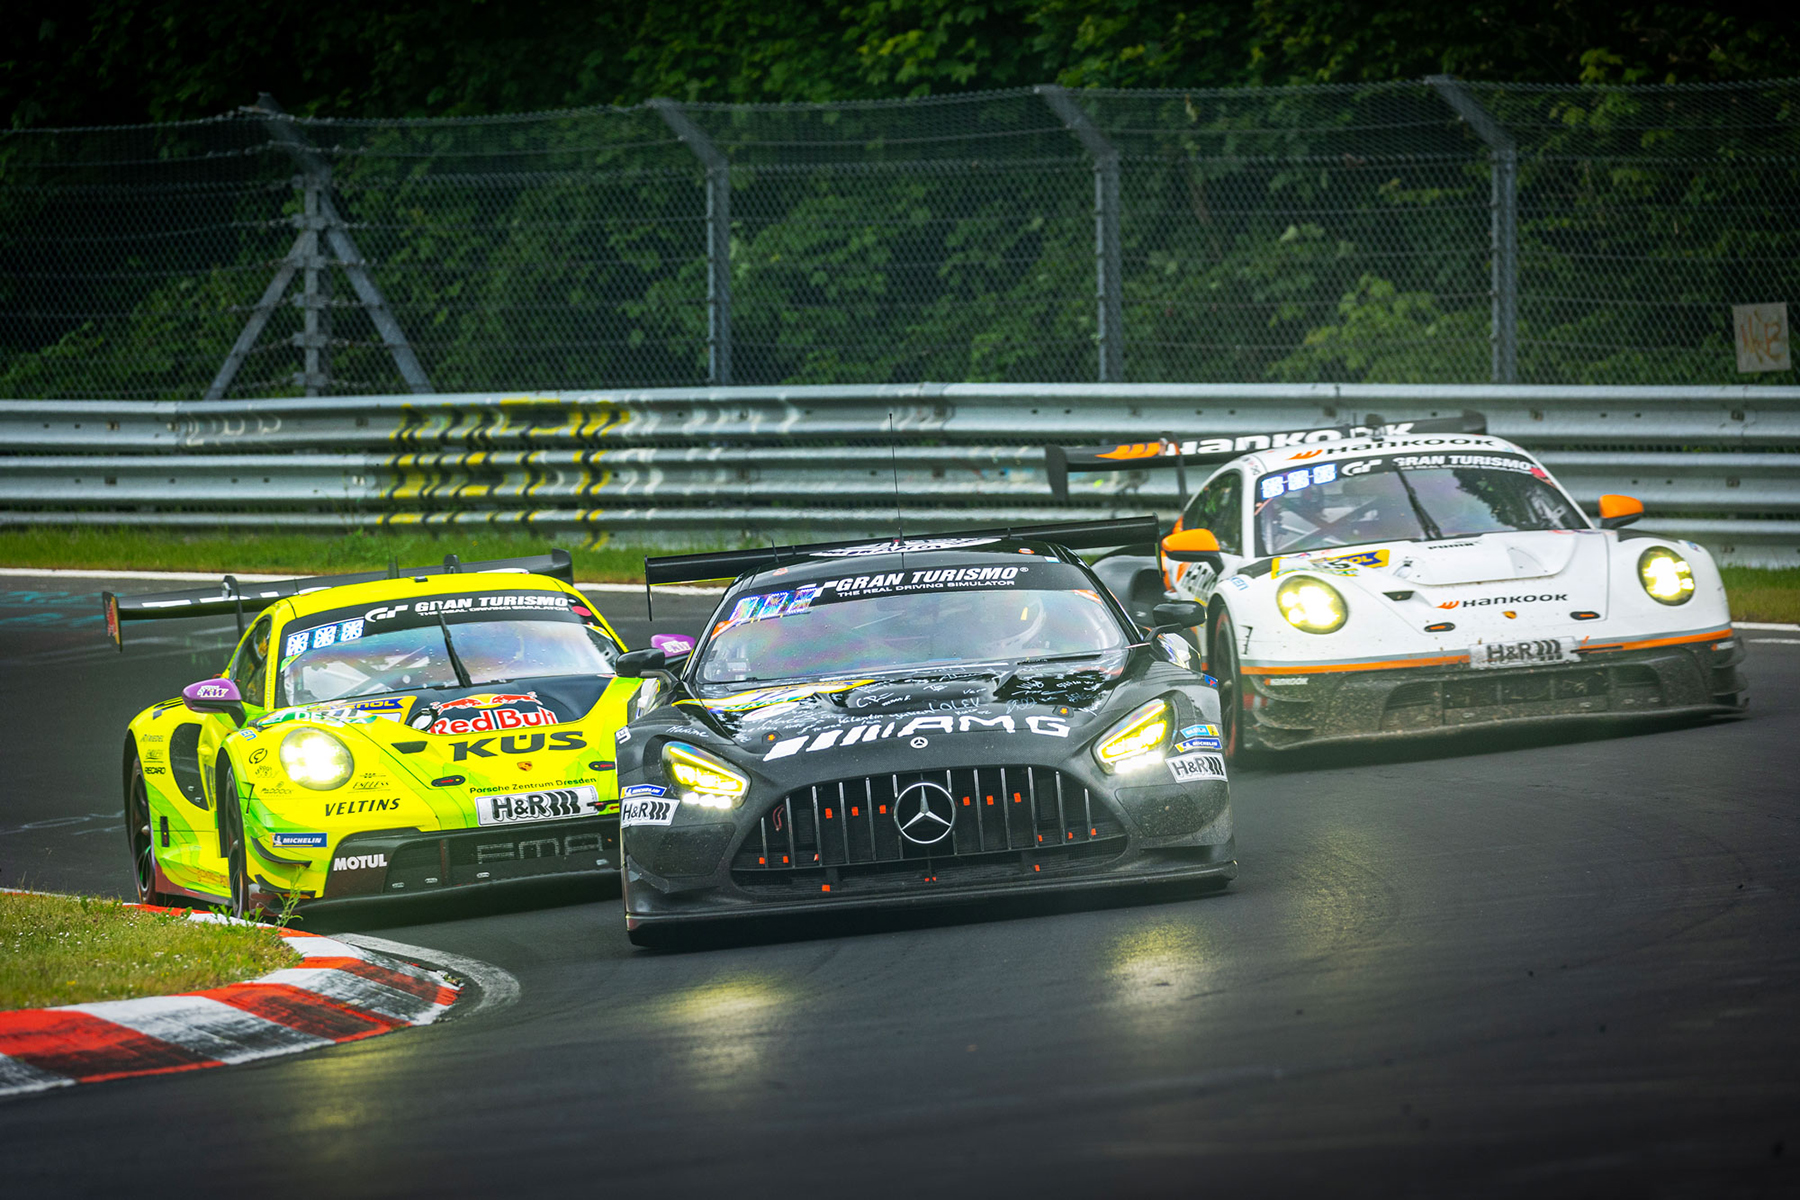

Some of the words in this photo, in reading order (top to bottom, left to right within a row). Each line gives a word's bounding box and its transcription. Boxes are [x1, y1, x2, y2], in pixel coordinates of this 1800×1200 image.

[1448, 455, 1532, 471] TURISMO
[835, 573, 905, 592] GRAN
[895, 583, 944, 591] DRIVING
[414, 598, 473, 612] GRAN
[430, 710, 494, 734] Red
[496, 708, 557, 730] Bull
[897, 715, 1071, 738] AMG
[448, 730, 588, 762] KÜS
[1171, 757, 1209, 776] H&R
[469, 786, 510, 794] Porsche
[512, 780, 554, 791] Zentrum
[556, 777, 597, 786] Dresden
[325, 798, 401, 817] VELTINS
[492, 795, 549, 822] H&R
[622, 801, 649, 821] H&R
[333, 853, 388, 871] MOTUL
